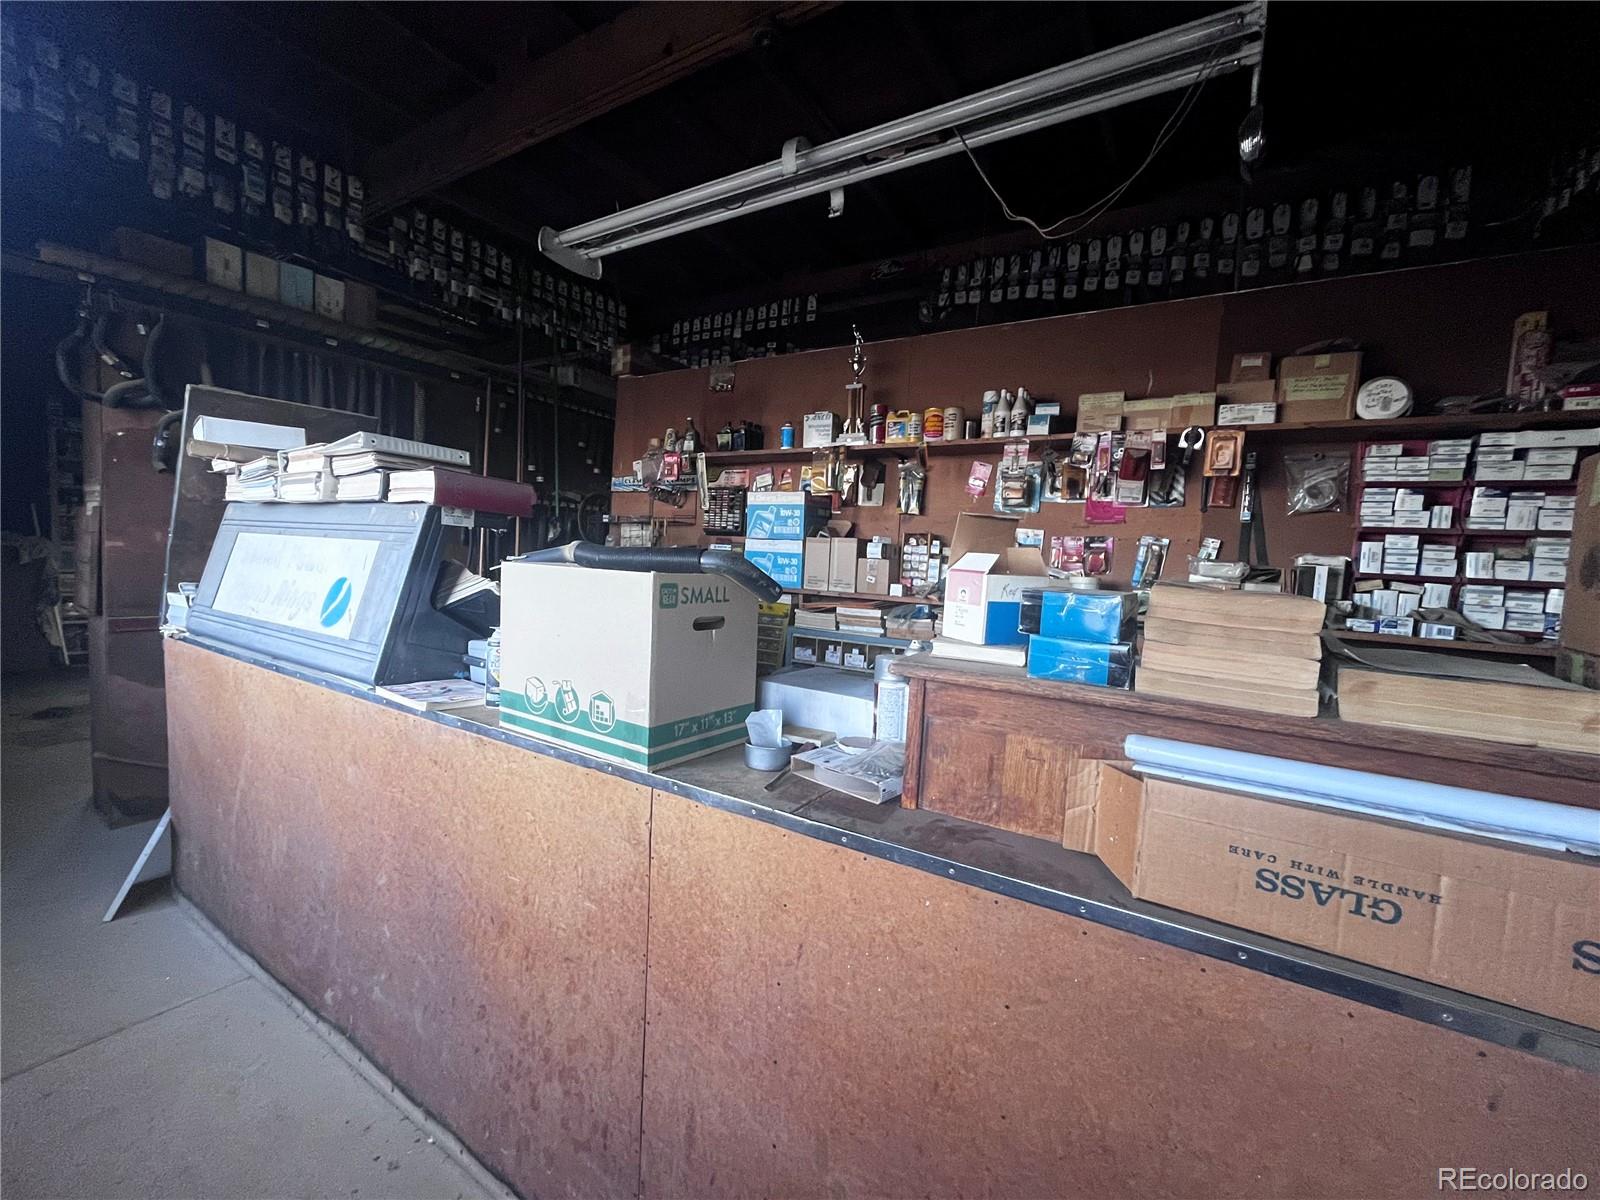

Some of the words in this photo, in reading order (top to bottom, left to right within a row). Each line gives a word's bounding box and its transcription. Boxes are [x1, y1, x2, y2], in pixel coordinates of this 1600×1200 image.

[680, 585, 730, 605] SMALL
[1228, 844, 1277, 864] CARE
[1290, 859, 1341, 881] WITH
[1255, 867, 1404, 926] GLASS
[1353, 874, 1442, 905] HANDLE
